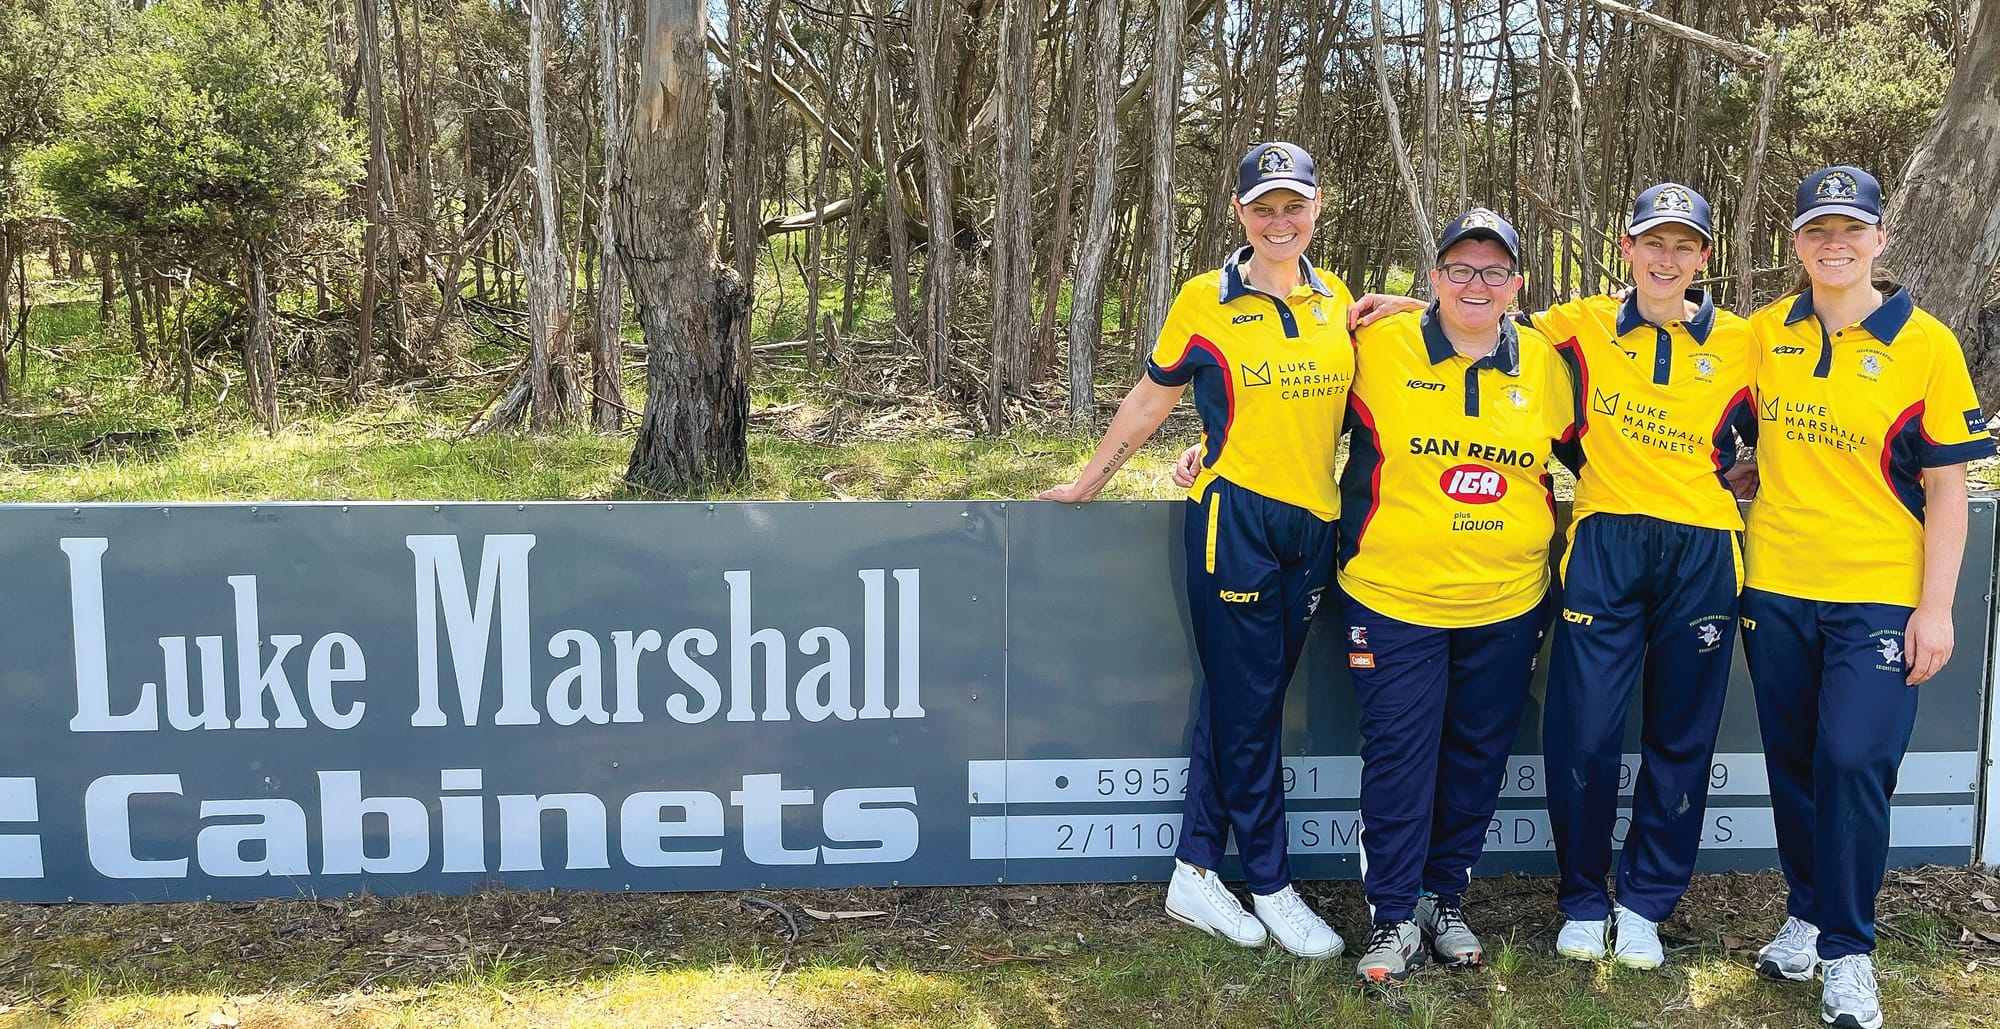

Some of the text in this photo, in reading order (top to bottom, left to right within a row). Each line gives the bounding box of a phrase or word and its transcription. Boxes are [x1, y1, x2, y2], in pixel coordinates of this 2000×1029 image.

[1279, 362, 1316, 373] LUKE
[1281, 371, 1350, 387] MARSHALL
[1281, 385, 1345, 400] CABINETS
[1626, 400, 1668, 420] LUKE
[1786, 402, 1827, 417] LUKE
[1621, 428, 1694, 454] CABINETS
[1623, 414, 1705, 446] MARSHALL
[1785, 416, 1867, 445] MARSHALL
[1786, 430, 1857, 452] CABINET
[1410, 437, 1535, 469] SAN REMO
[1452, 520, 1504, 531] LIQUOR
[1454, 511, 1471, 519] plus
[60, 533, 926, 733] Luke Marshall
[84, 769, 920, 879] Cabinets
[1057, 823, 1175, 853] 2/110
